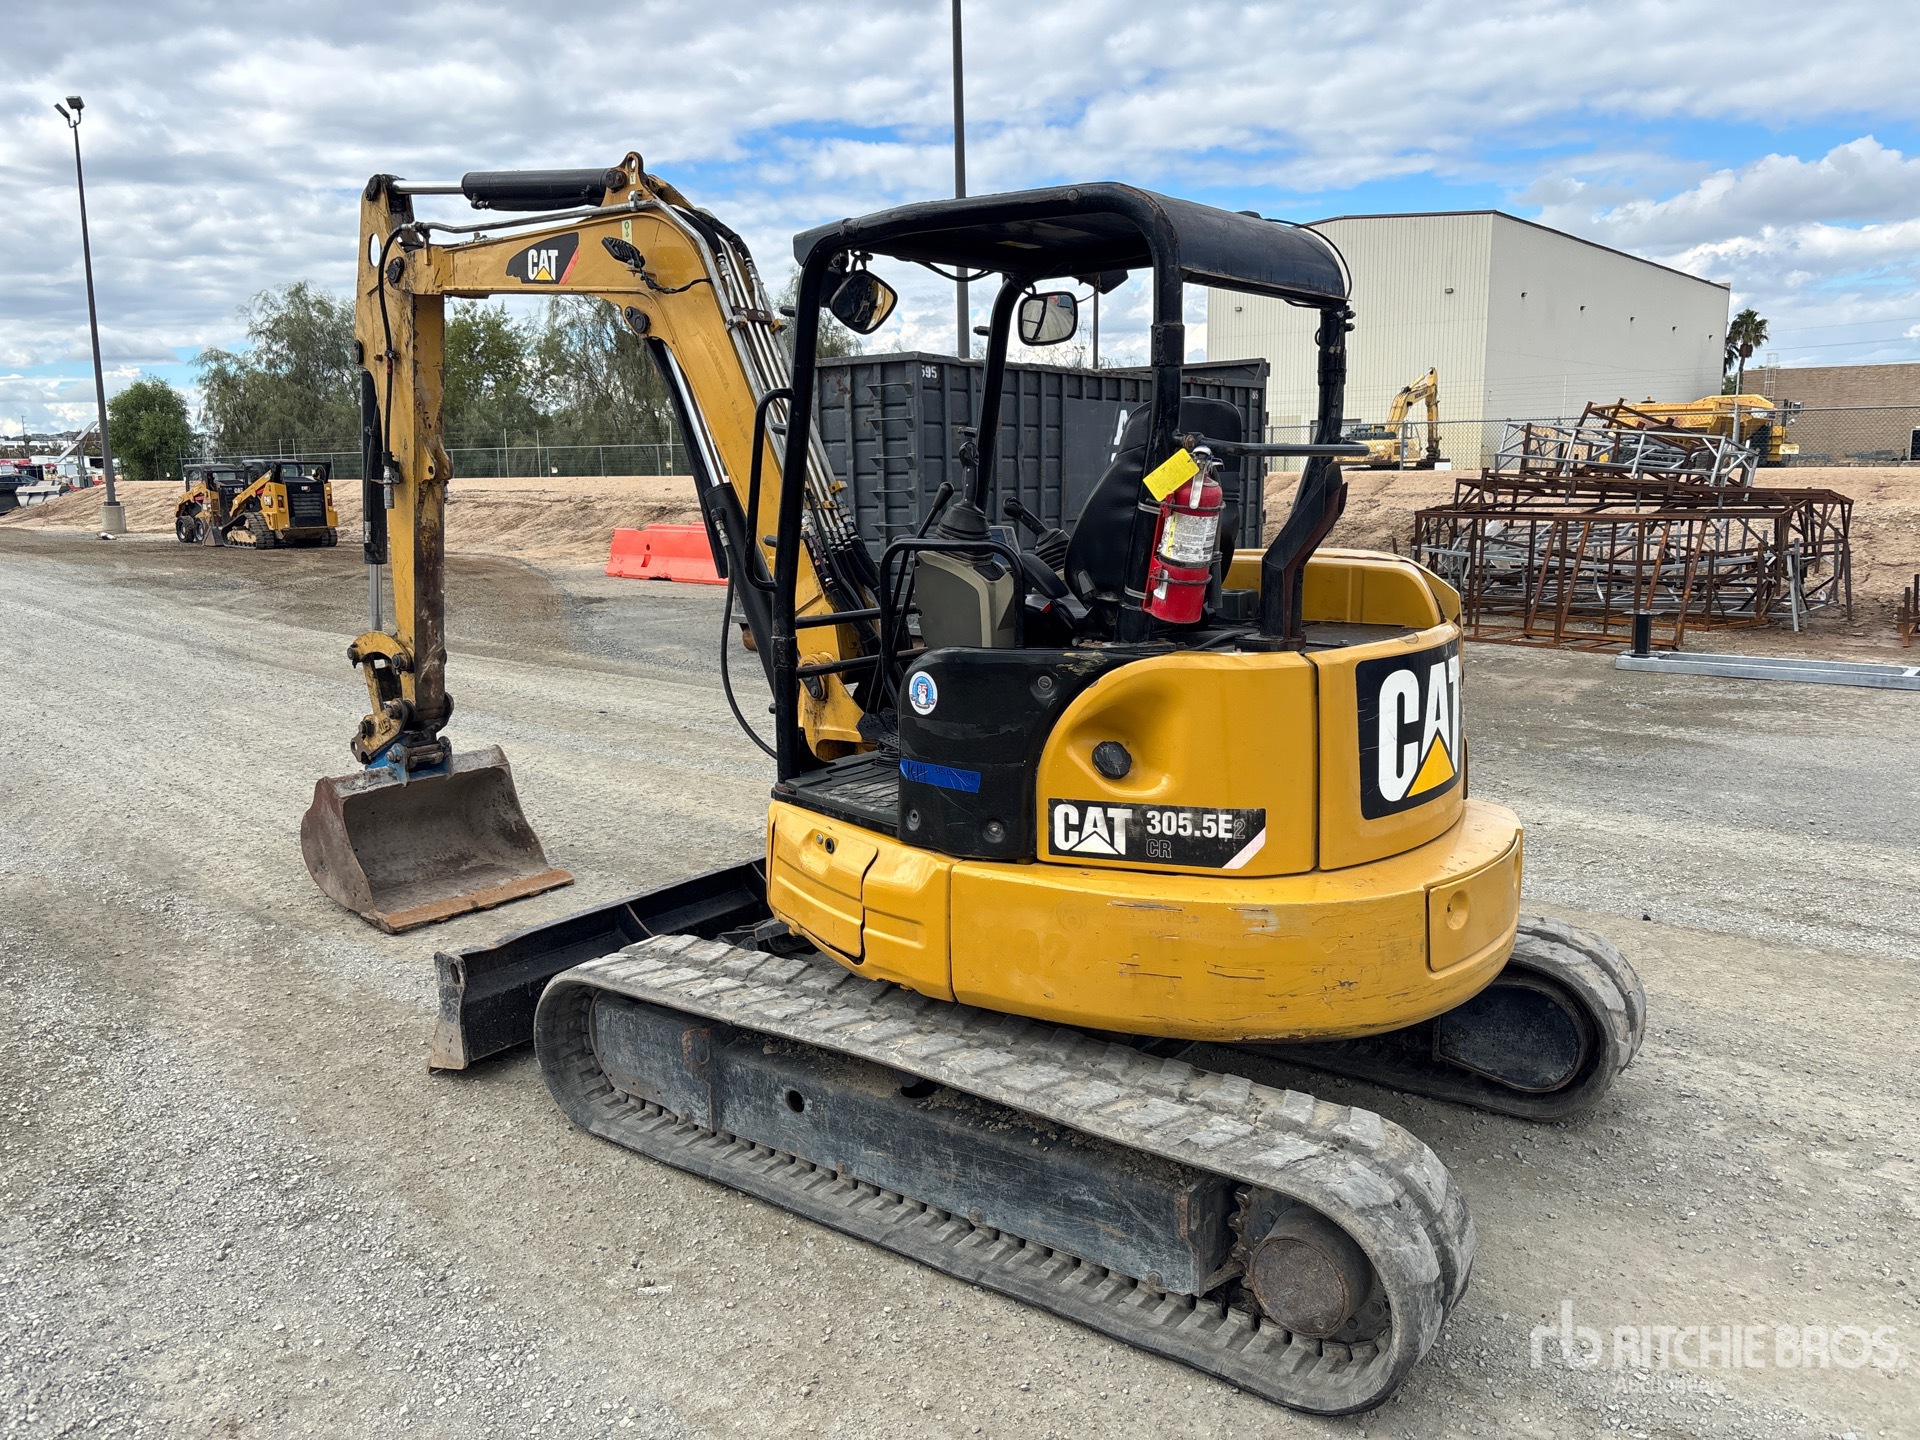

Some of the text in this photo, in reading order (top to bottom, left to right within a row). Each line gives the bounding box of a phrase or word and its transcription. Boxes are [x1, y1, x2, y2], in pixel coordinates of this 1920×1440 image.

[527, 248, 559, 280] CAT
[1377, 654, 1461, 802] CAT
[1053, 803, 1134, 856] CAT
[1145, 838, 1173, 859] CR
